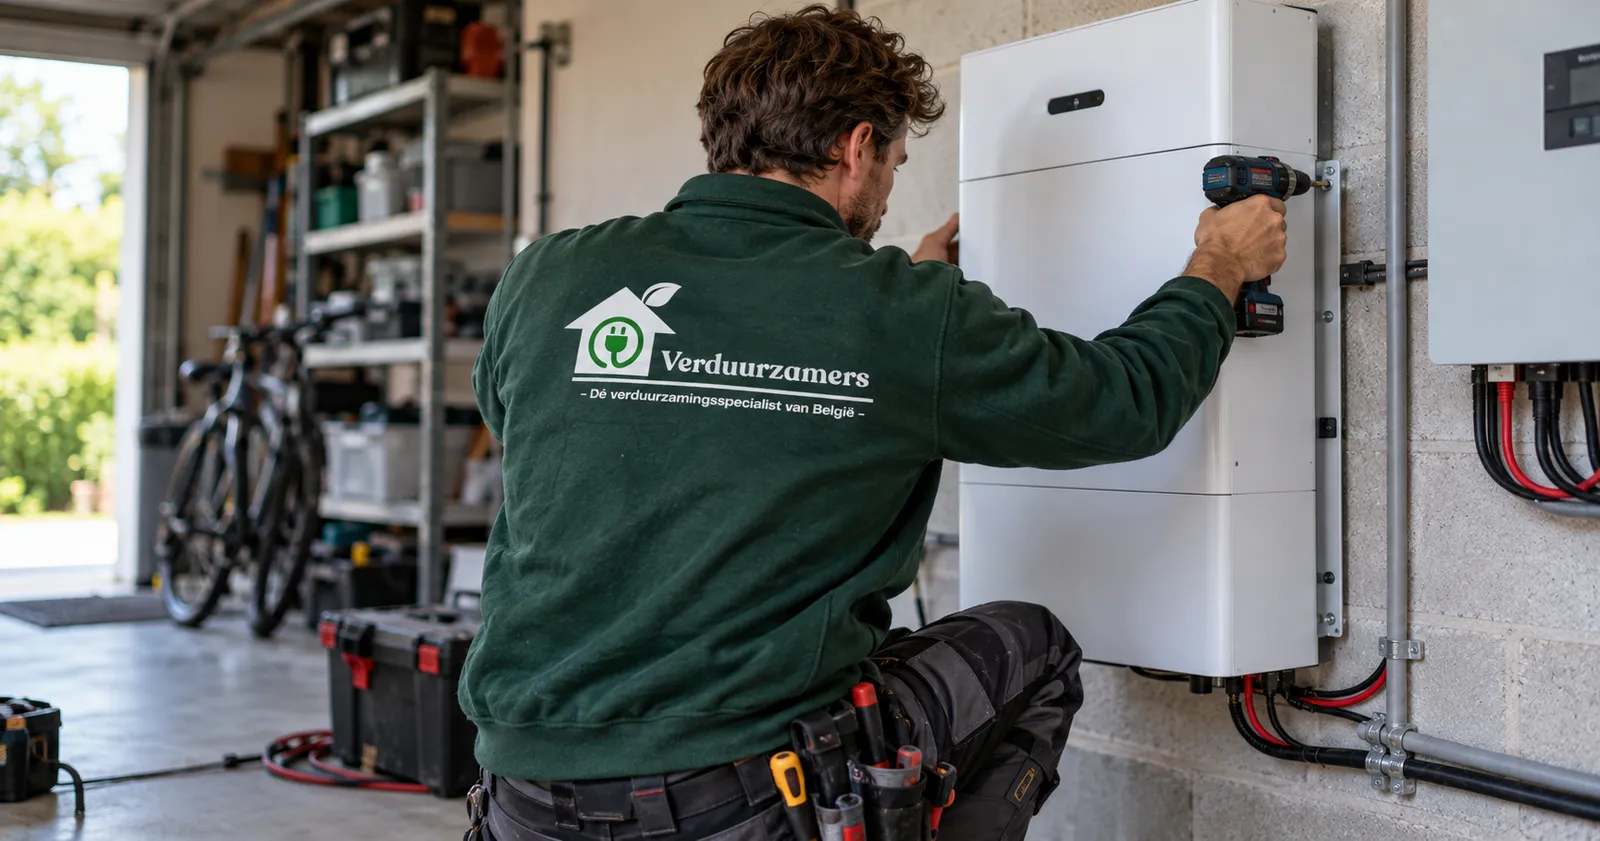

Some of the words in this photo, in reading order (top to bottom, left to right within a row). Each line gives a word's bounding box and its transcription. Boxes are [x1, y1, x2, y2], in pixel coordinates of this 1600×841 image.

[661, 349, 870, 388] Verduurzamers
[589, 388, 607, 400] Dé
[610, 389, 783, 412] verduurzamingsspecialist
[785, 403, 809, 414] van
[812, 403, 855, 419] België
